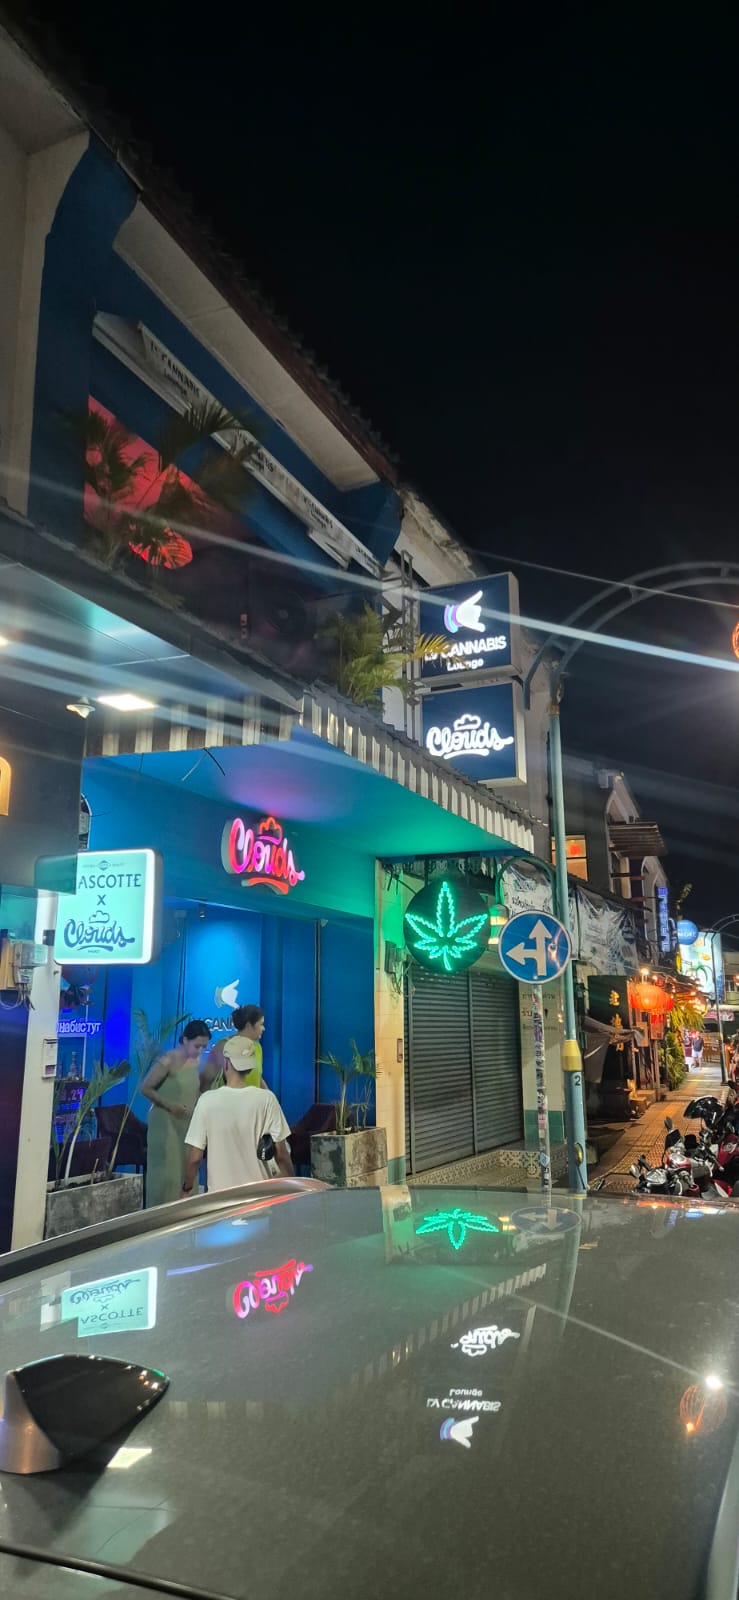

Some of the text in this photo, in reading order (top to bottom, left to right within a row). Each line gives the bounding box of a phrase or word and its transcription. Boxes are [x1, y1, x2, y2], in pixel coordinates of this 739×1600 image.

[426, 721, 514, 757] Clouds
[228, 817, 306, 889] Clouds
[63, 918, 136, 948] Clouds
[574, 1074, 581, 1086] 2
